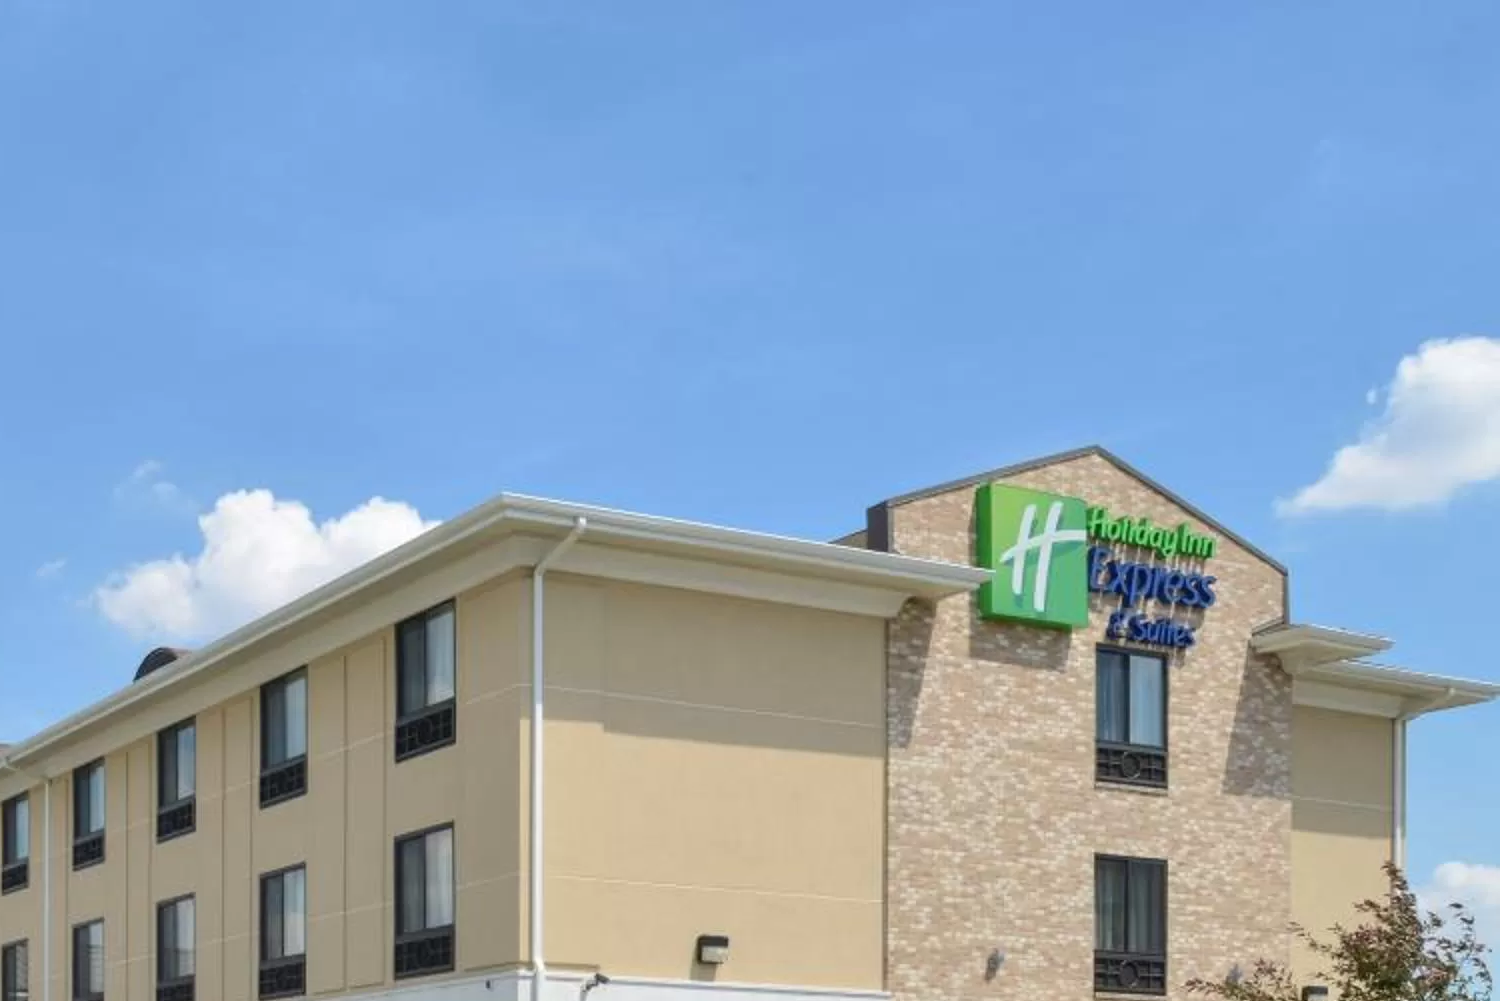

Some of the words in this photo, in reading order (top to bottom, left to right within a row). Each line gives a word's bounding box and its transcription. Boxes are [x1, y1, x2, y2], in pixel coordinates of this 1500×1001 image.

[1087, 508, 1178, 557] Holiday
[1178, 523, 1216, 559] Inn
[1088, 544, 1218, 608] Express
[1128, 614, 1195, 647] Suites
